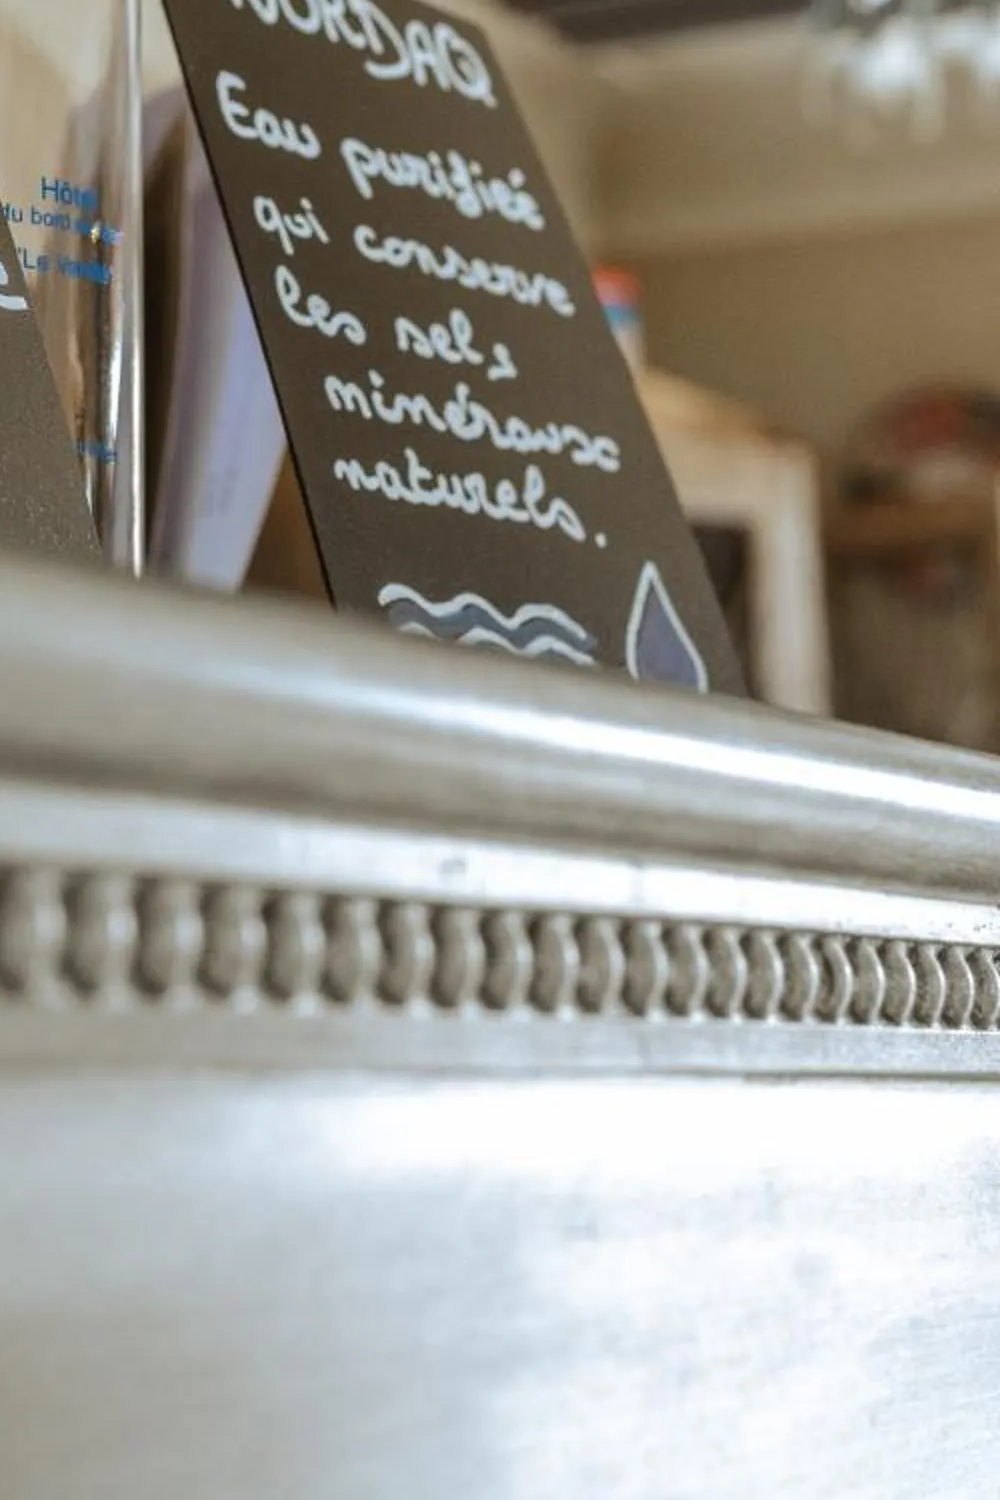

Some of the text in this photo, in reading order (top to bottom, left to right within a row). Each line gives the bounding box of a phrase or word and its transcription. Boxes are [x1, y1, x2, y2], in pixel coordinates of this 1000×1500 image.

[215, 70, 546, 231] Eau purifiée
[253, 196, 576, 317] qui conserve
[275, 264, 518, 382] les sels
[324, 369, 621, 473] minéraux
[333, 447, 608, 549] naturels.
